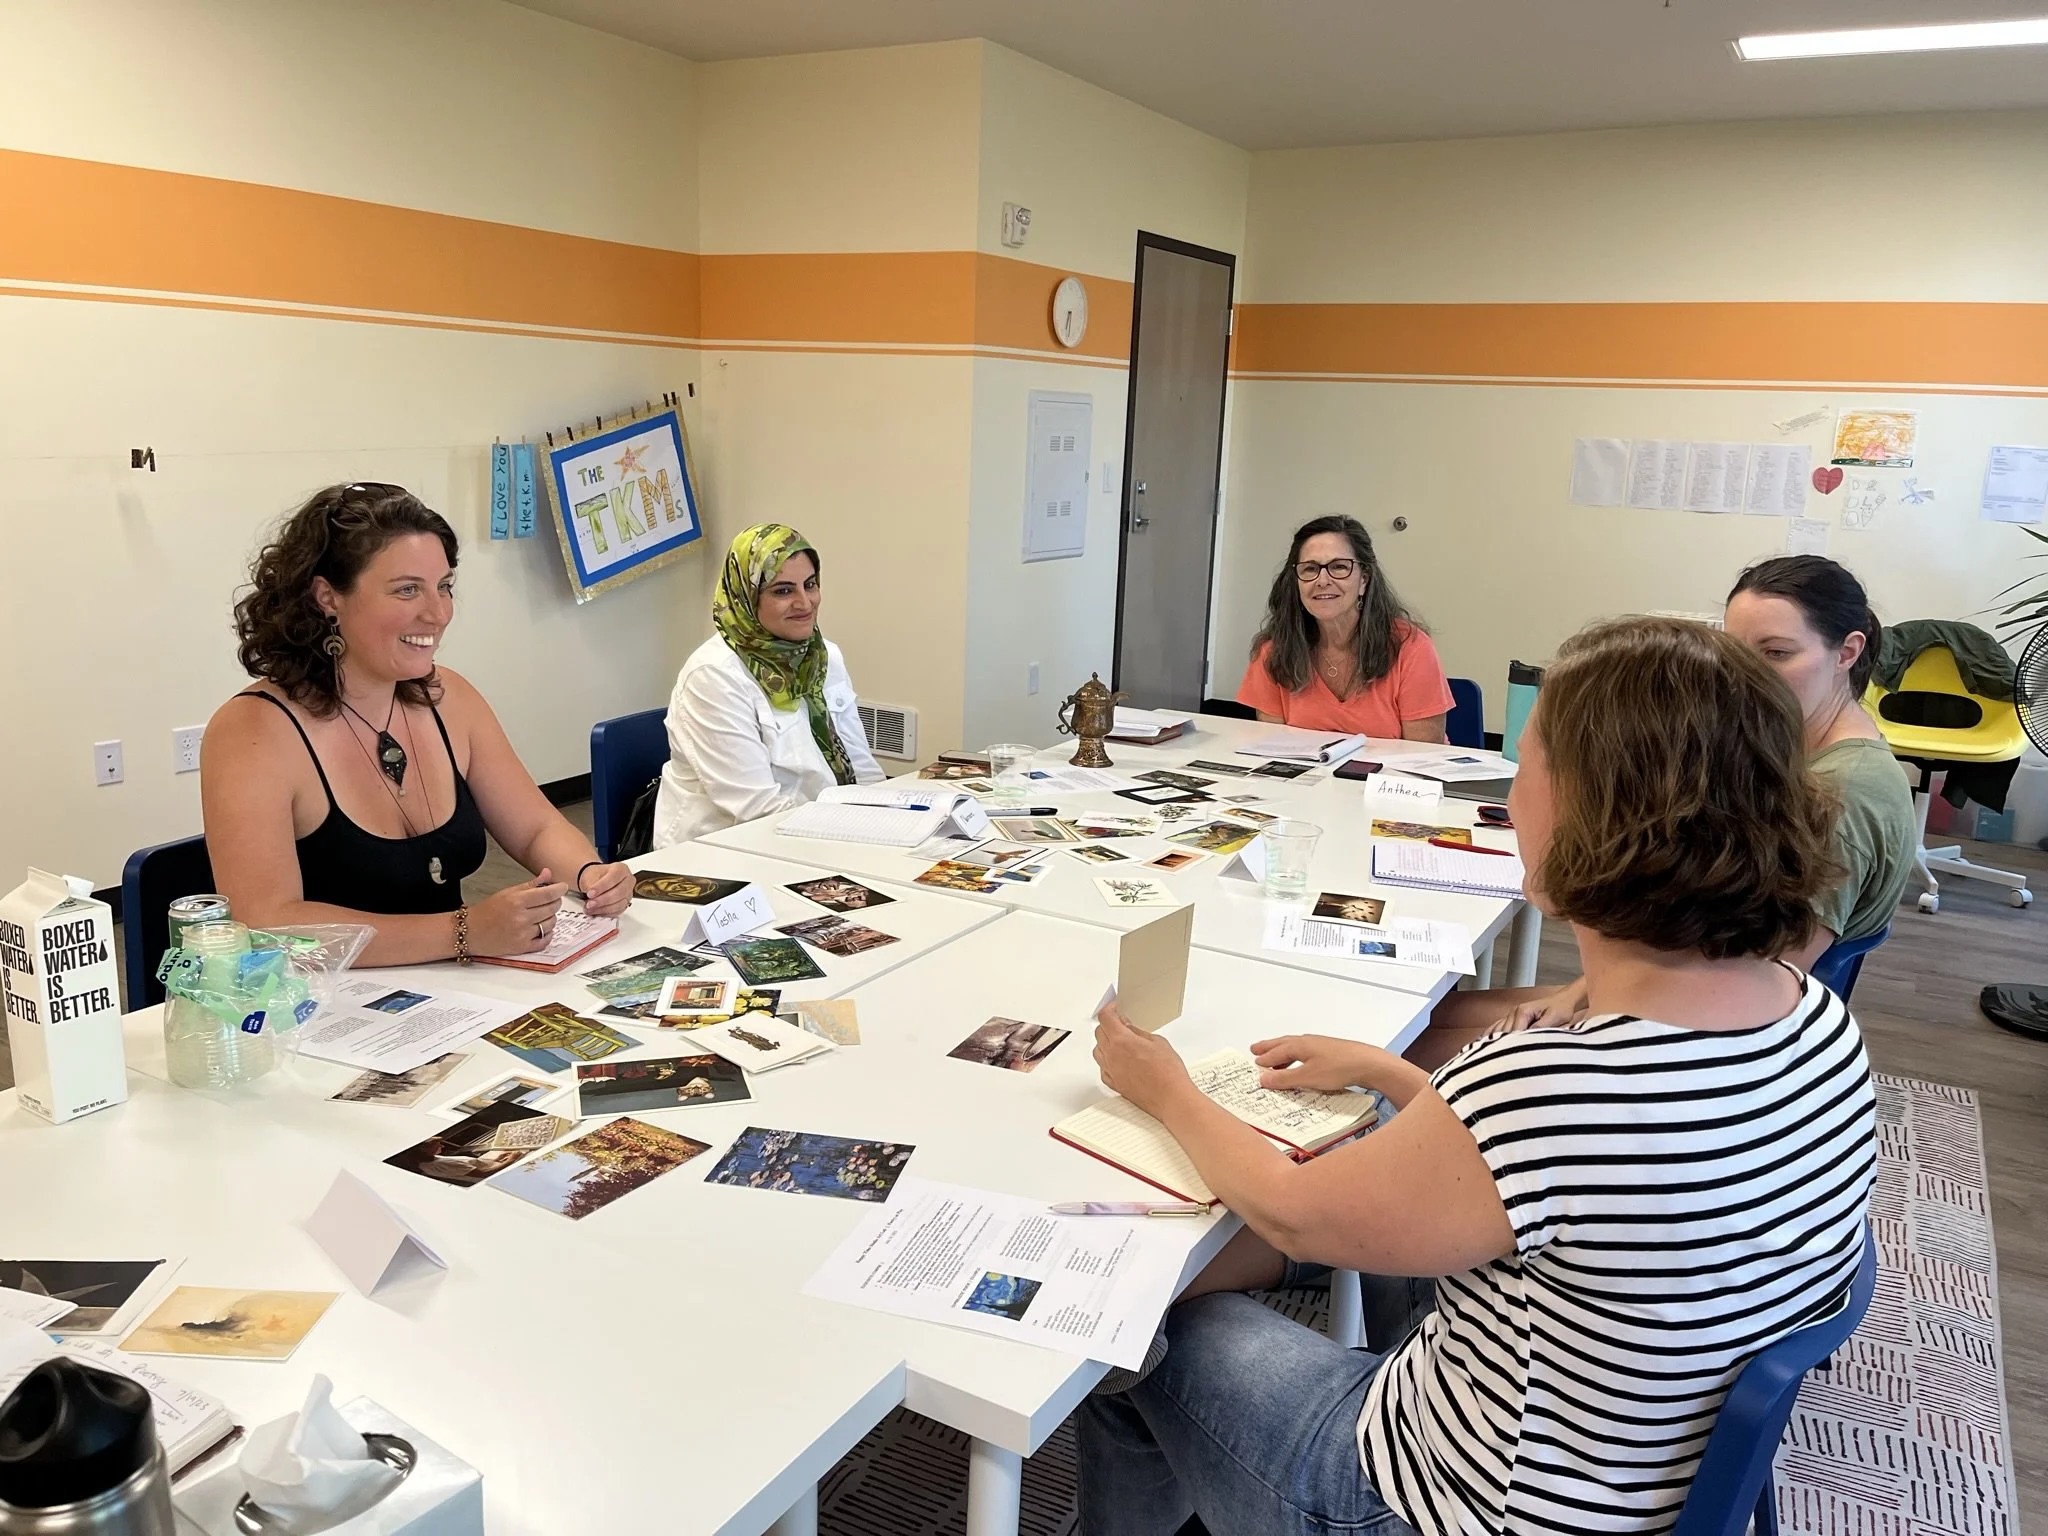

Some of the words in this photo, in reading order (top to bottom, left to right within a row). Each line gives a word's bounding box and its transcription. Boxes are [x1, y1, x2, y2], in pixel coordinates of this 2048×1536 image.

[577, 465, 605, 487] THE
[495, 526, 508, 536] I
[1377, 780, 1423, 799] Anthea
[707, 903, 741, 929] Tasha
[42, 918, 95, 952] BOXED
[44, 942, 99, 976] WATER
[3, 967, 12, 991] IS
[47, 975, 64, 1000] IS
[5, 990, 41, 1025] BETTER.
[49, 986, 115, 1025] BETTER.
